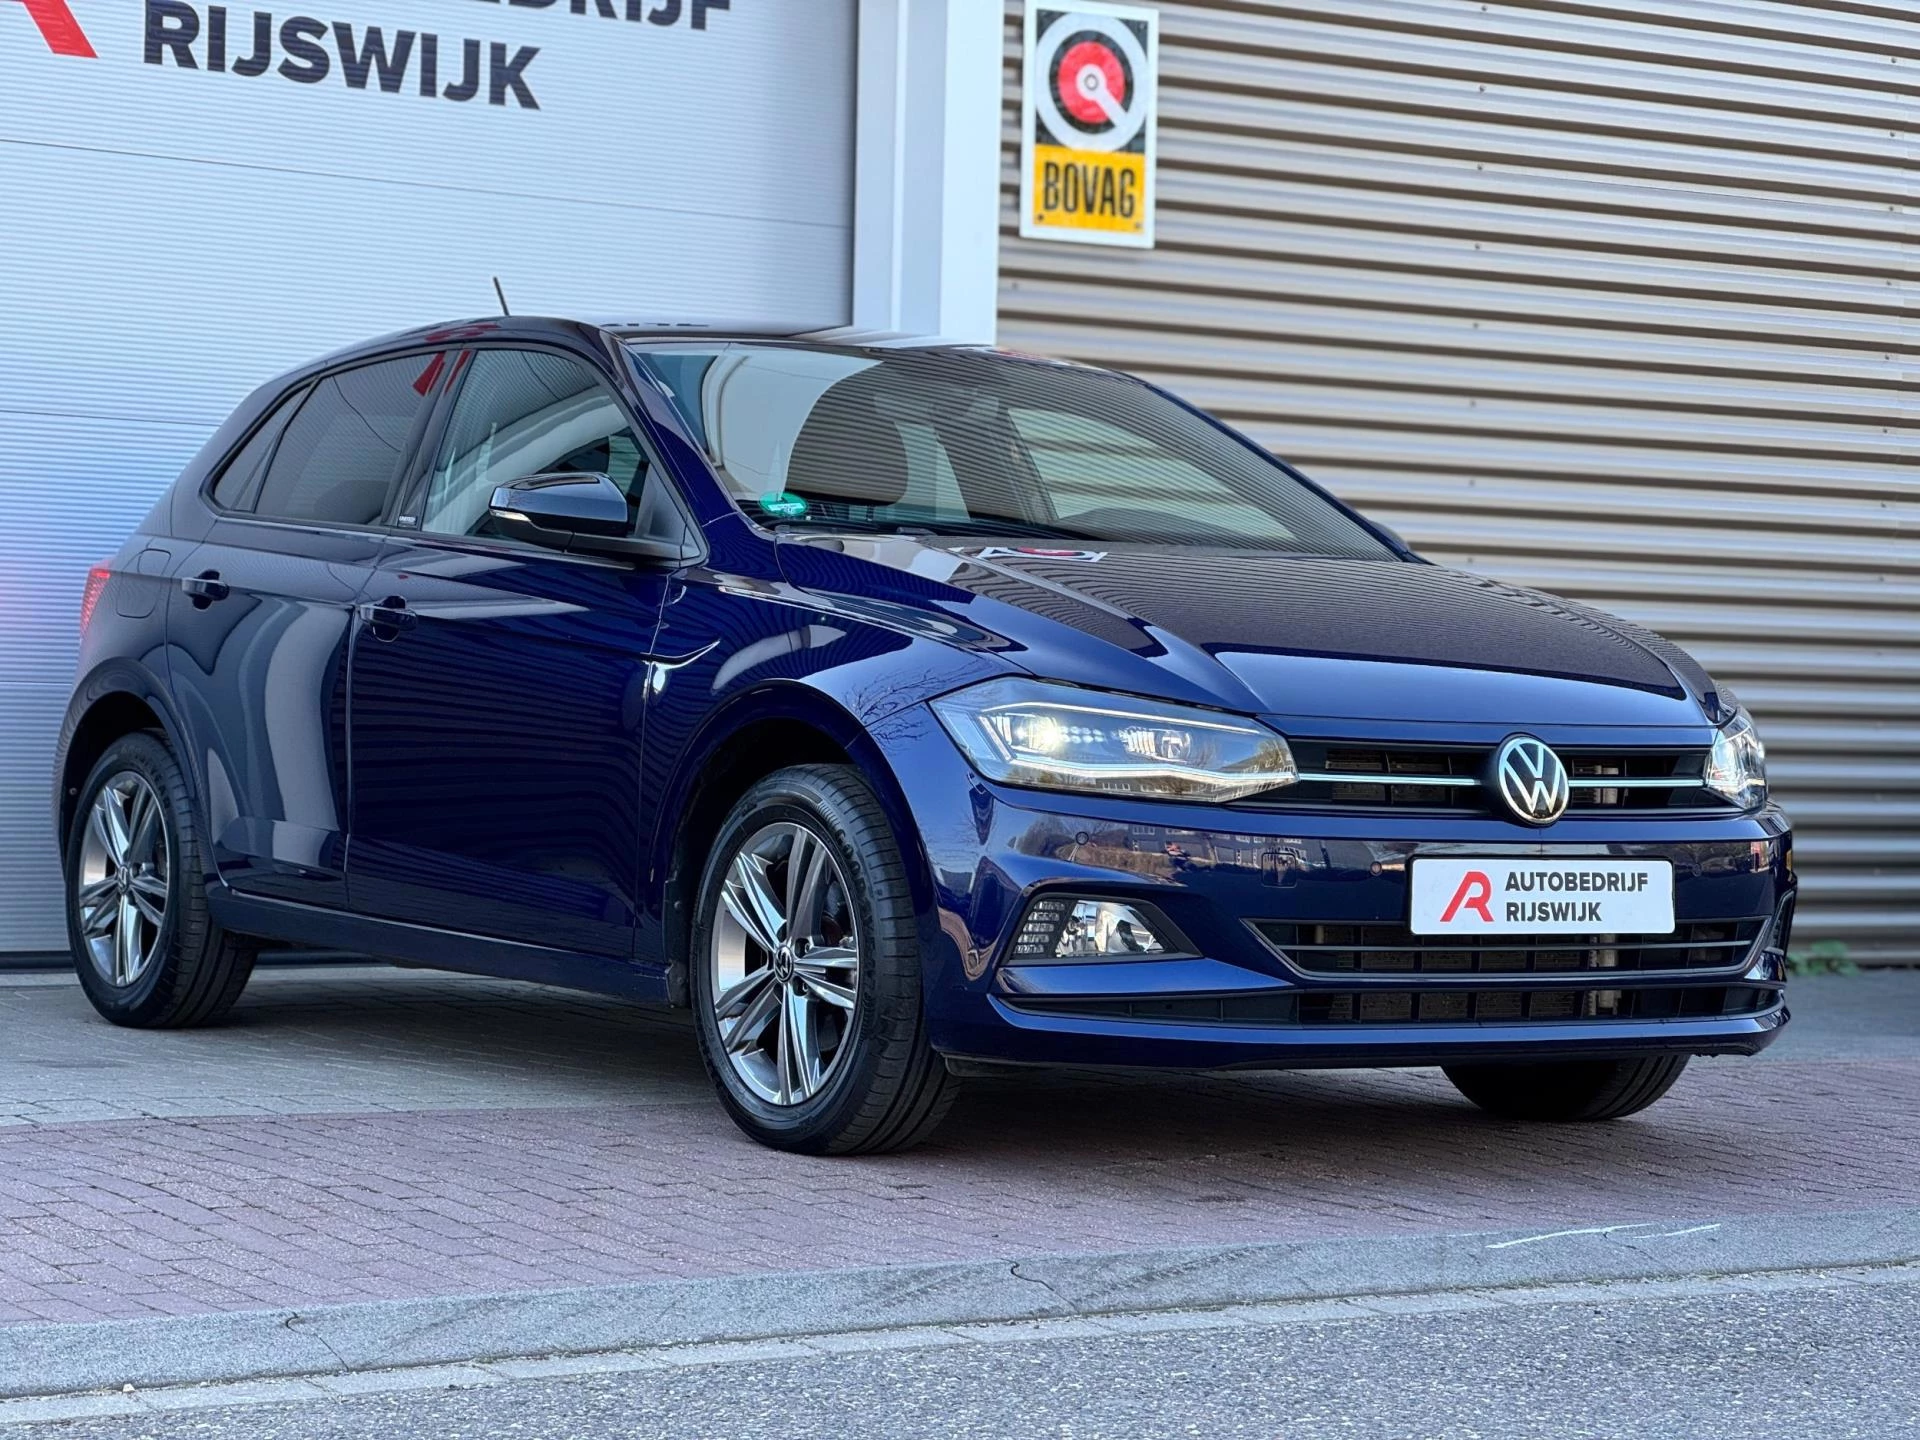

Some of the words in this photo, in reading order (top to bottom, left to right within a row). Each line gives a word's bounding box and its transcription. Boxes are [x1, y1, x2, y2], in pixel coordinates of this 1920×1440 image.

[143, 0, 541, 111] RIJSWIJK
[1044, 161, 1135, 218] BOVAG
[1505, 871, 1648, 892] AUTOBEDRIJF
[1506, 901, 1602, 922] RIJSWIJK
